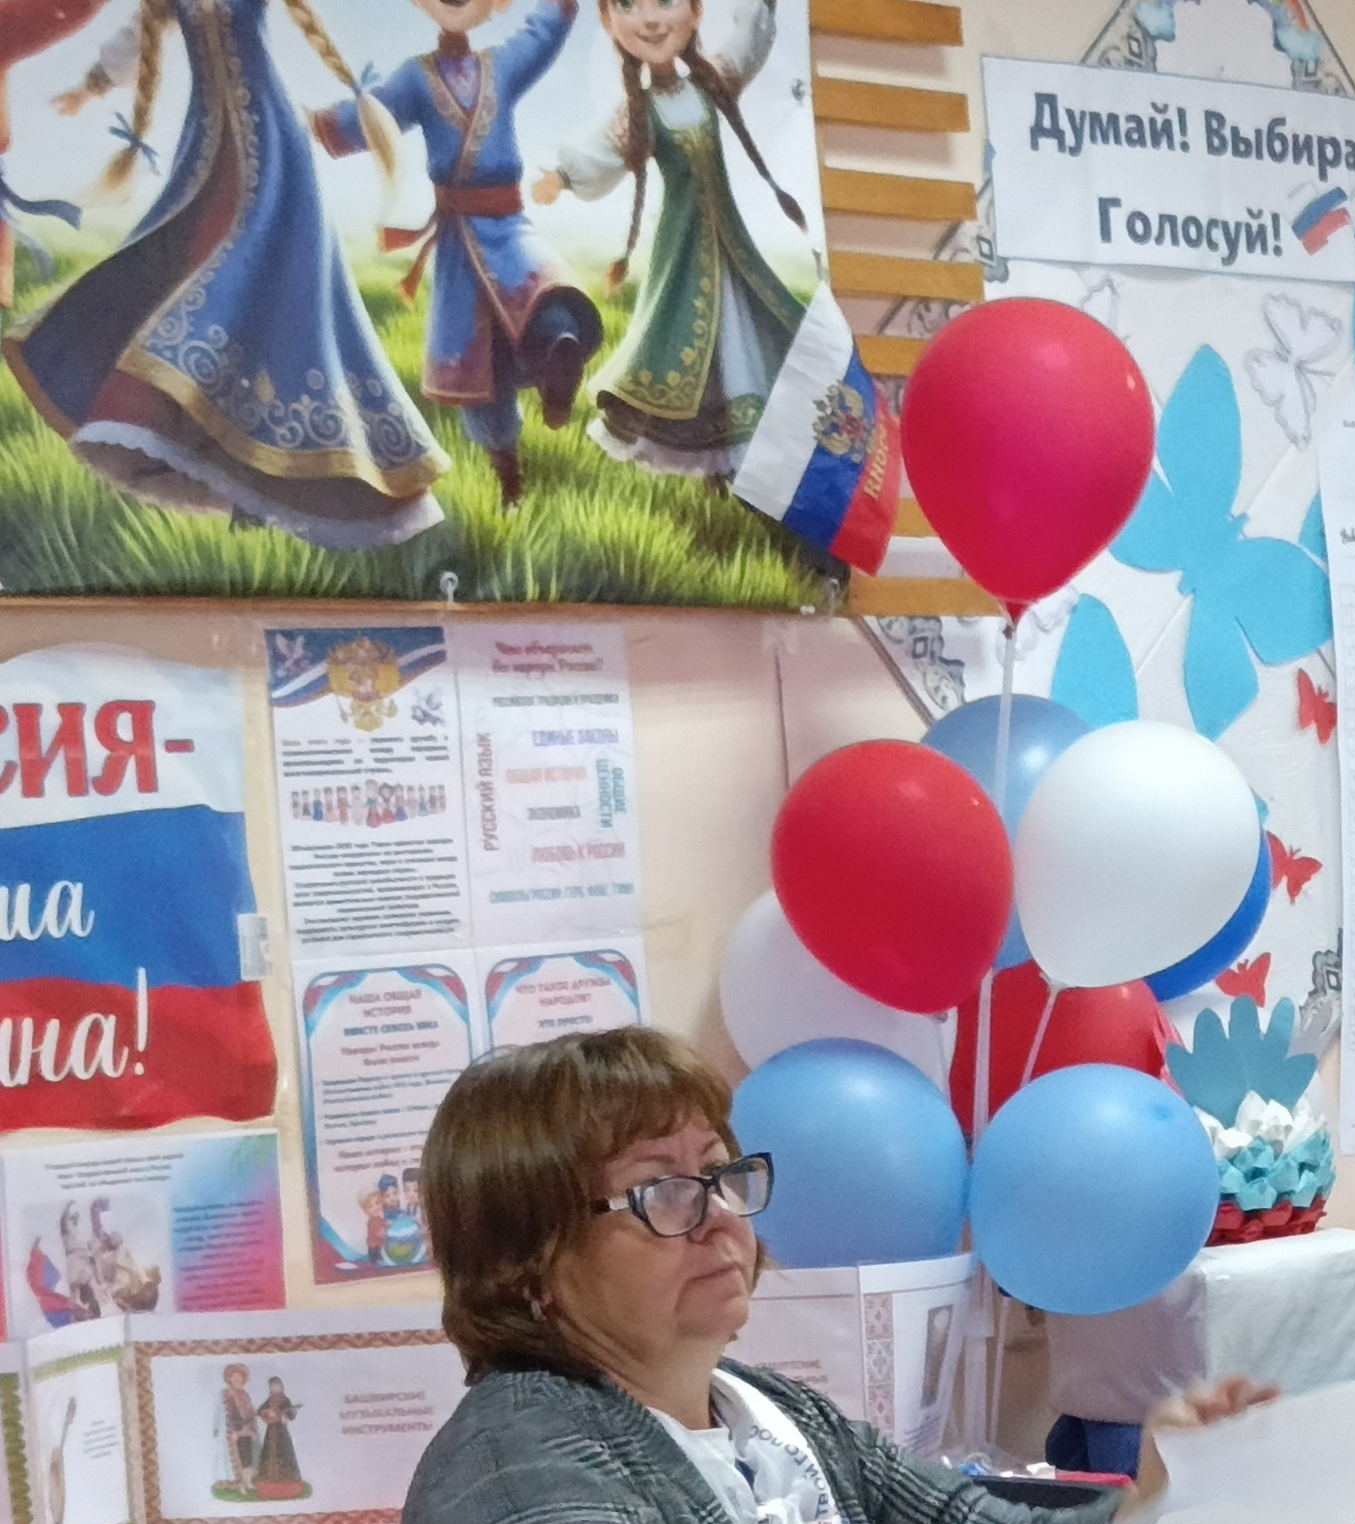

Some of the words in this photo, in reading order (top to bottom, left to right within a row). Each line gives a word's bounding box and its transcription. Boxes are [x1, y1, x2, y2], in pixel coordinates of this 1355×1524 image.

[1030, 92, 1189, 155] Думай!
[1098, 197, 1283, 266] Голосуй!
[0, 699, 195, 799] ИЯ-
[476, 732, 493, 778] ЯЗЫК
[476, 781, 499, 851] РУССКИЙ
[339, 1406, 434, 1420] МУЗЫКАЛЬНЫЕ
[344, 1391, 427, 1405] БАШКИРСКИЕ
[341, 1421, 433, 1436] ИНСТРУМЕНТЫ
[750, 1424, 809, 1467] ГОЛОС
[805, 1462, 831, 1520] ТВОЙ
